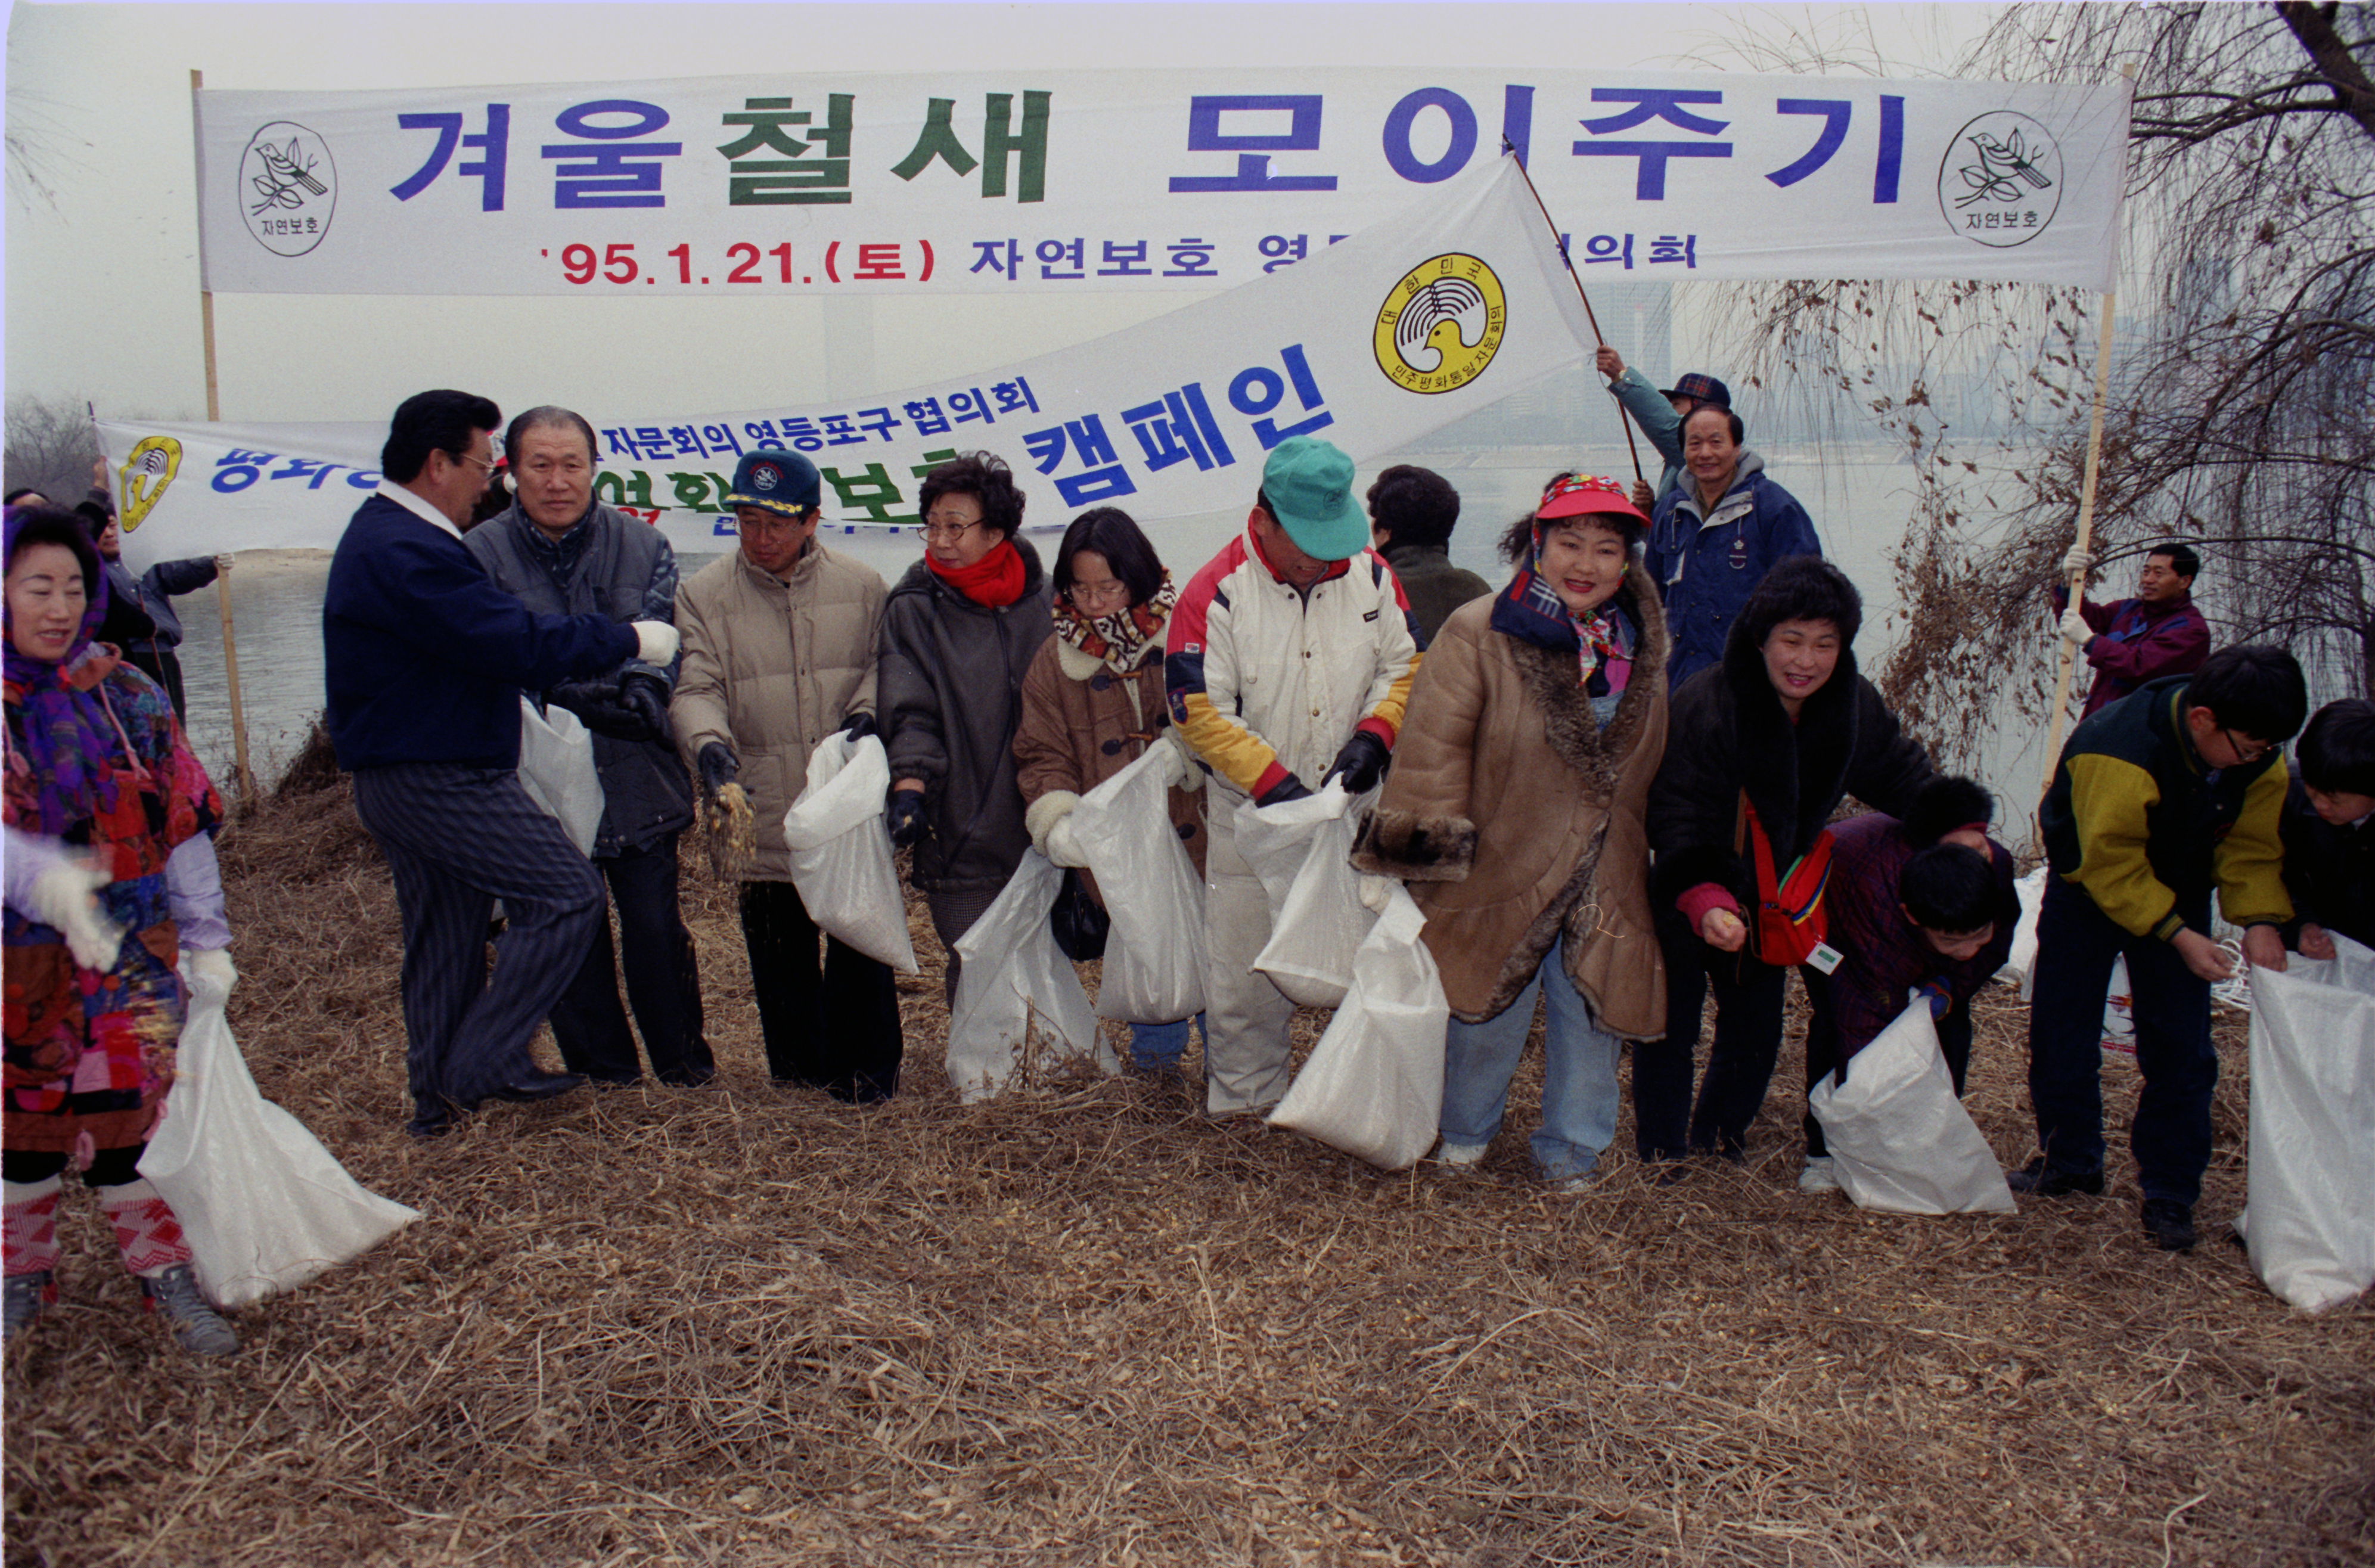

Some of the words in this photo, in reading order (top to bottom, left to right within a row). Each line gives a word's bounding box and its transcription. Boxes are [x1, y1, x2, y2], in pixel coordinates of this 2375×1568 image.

[262, 217, 319, 235] 자연보호
[1966, 210, 2038, 229] 자연보호
[969, 237, 1218, 281] 자연보호
[1380, 256, 1482, 325] 대한민국
[1022, 343, 1335, 508] 캠페인
